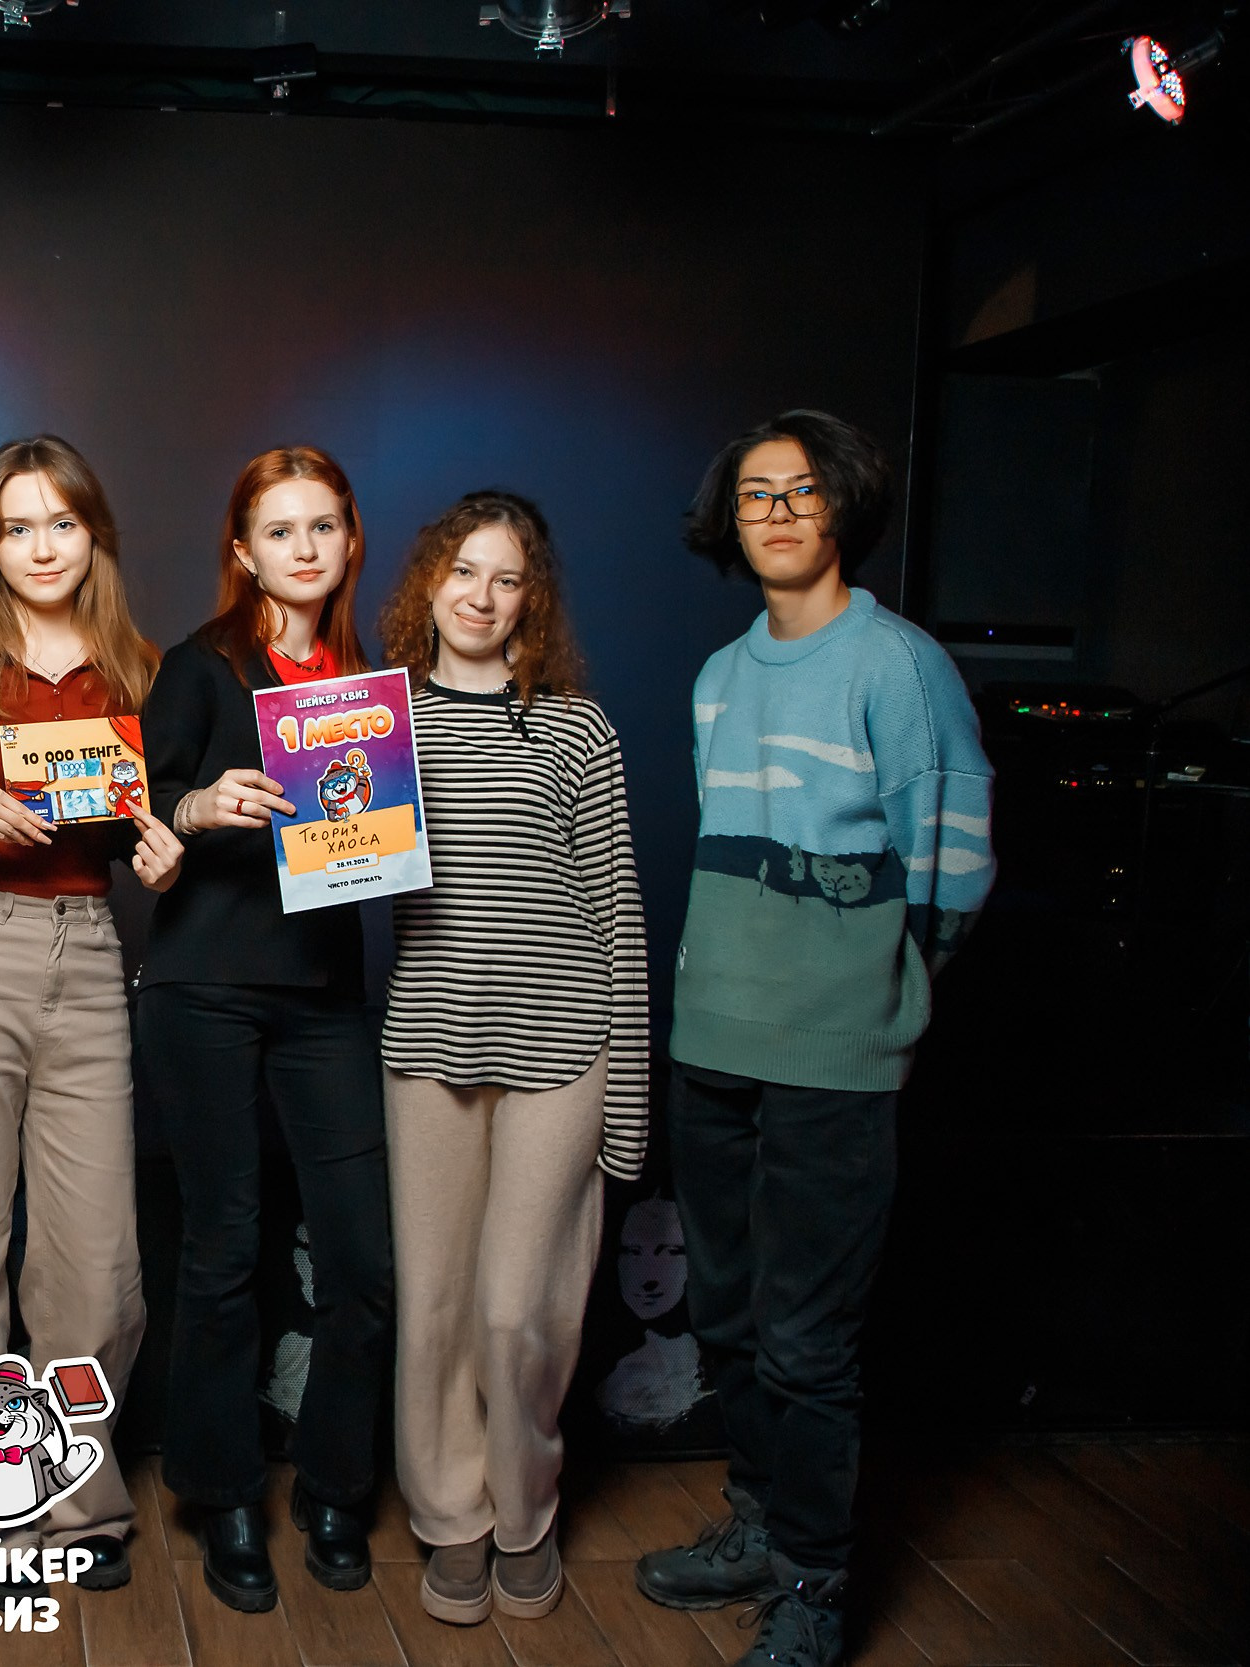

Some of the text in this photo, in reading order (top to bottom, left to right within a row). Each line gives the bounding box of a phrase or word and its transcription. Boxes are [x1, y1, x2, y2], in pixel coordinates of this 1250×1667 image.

[295, 689, 369, 709] ШЕЙКЕР КВИЗ
[278, 705, 393, 752] 1 МЕСТО
[22, 744, 122, 765] 10 000 ТЕНГЕ
[327, 833, 381, 854] ХАОСА
[336, 857, 370, 868] 28.11.2024
[327, 875, 383, 890] ЧИСТО ПОРЖАТЬ
